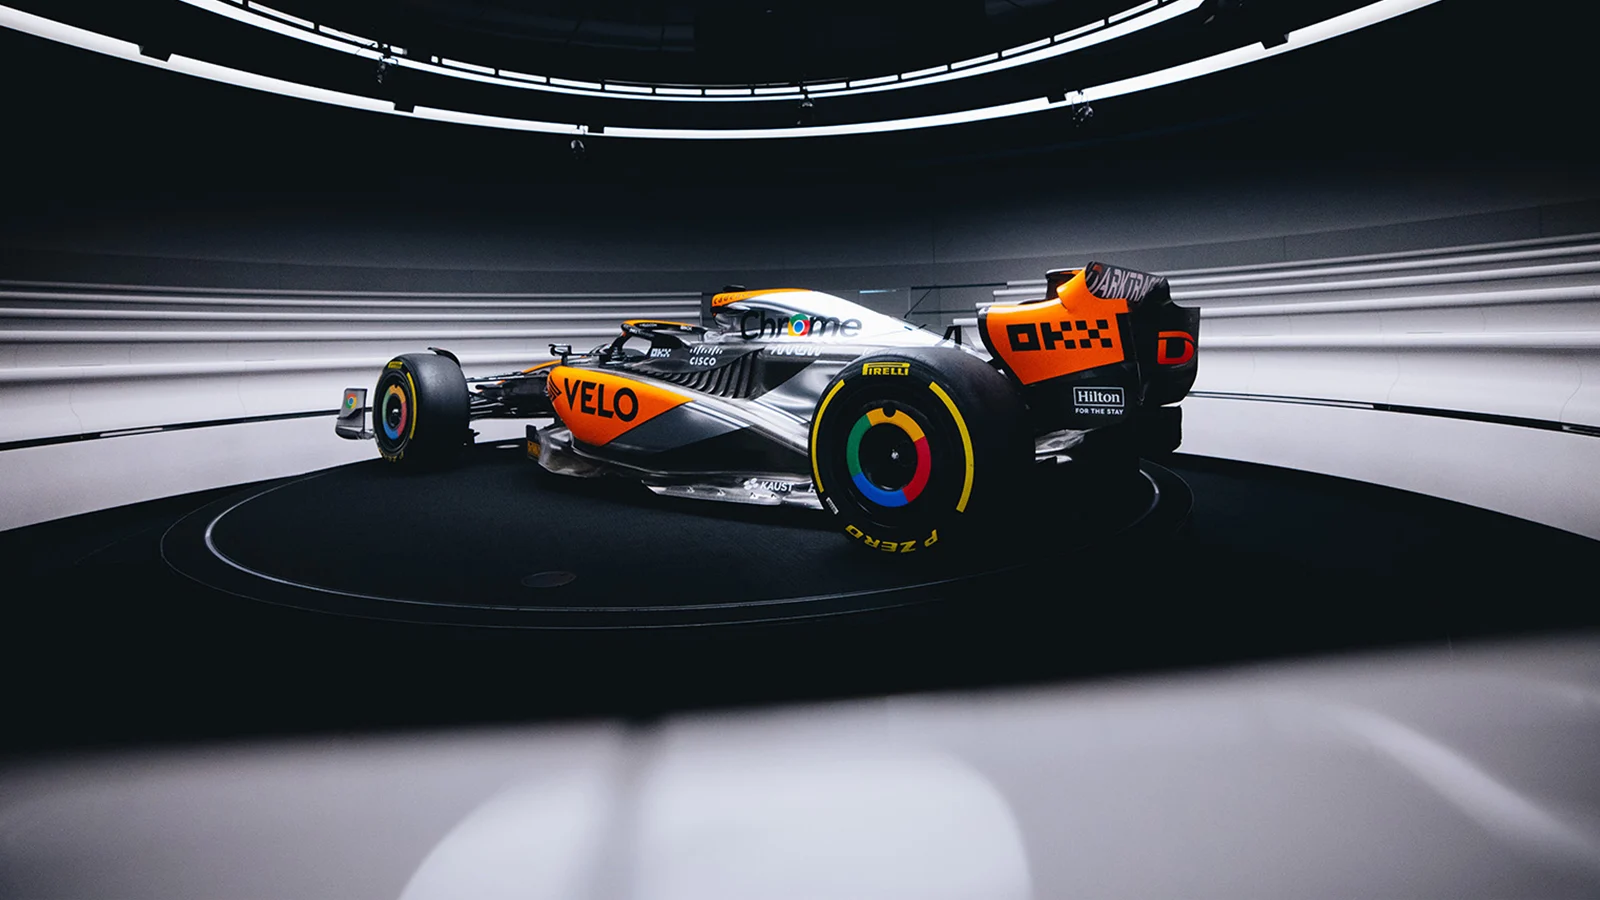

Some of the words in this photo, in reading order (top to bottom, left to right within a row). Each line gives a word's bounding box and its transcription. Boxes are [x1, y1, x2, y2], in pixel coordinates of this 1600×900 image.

[740, 310, 862, 340] Chrome
[1006, 319, 1113, 352] OKX
[689, 355, 717, 367] CISCO
[862, 361, 911, 376] PIRELLI
[564, 377, 639, 423] VELO
[1077, 390, 1121, 403] Hilton
[760, 481, 795, 492] KAUST
[845, 524, 917, 553] ZERO
[924, 529, 939, 547] P
